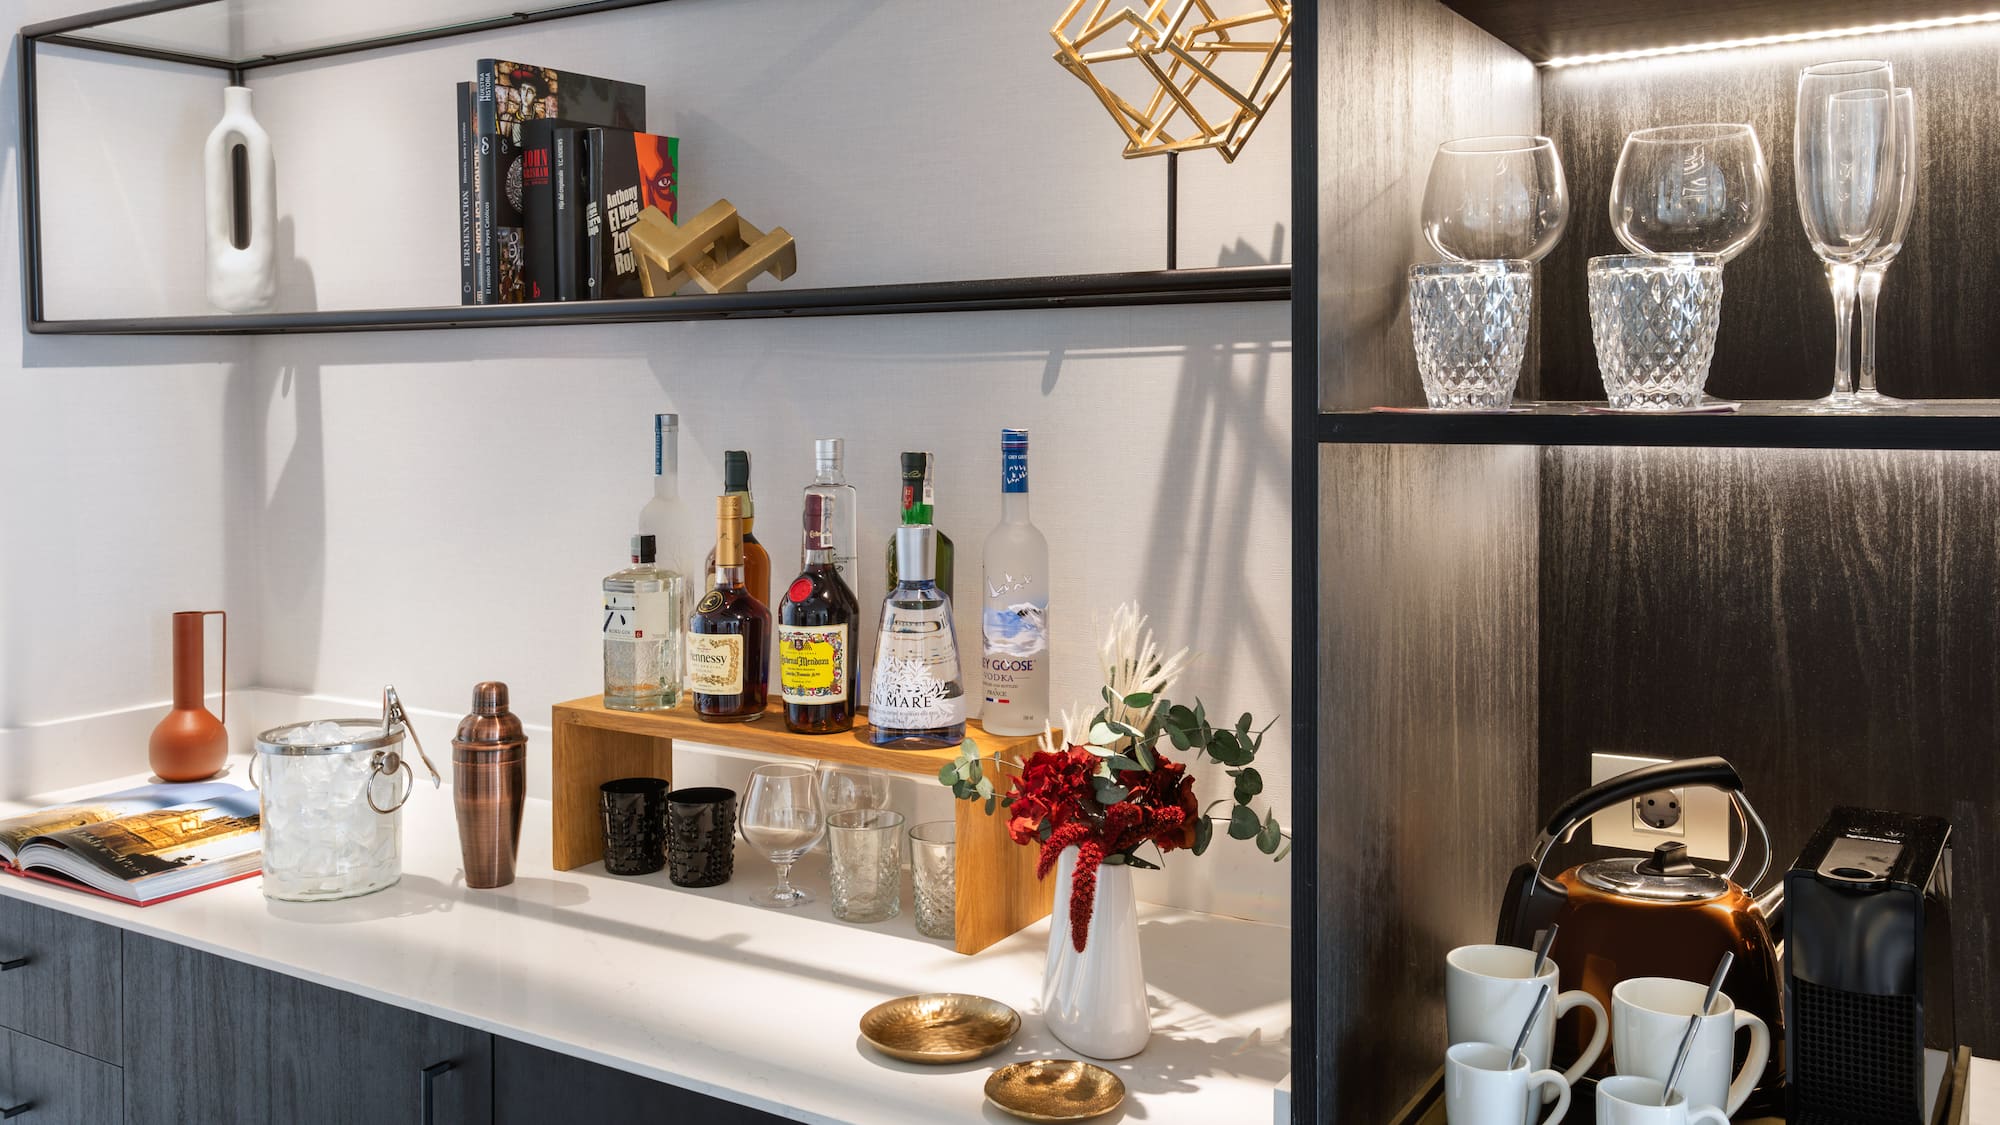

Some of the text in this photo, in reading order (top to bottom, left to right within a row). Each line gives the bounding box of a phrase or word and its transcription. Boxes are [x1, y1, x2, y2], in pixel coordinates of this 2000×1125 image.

[523, 148, 547, 168] JOHN
[606, 185, 638, 209] Anthony
[608, 207, 620, 232] El
[619, 201, 639, 220] Hyde
[614, 248, 637, 276] Roj
[692, 654, 727, 666] ennessy
[992, 659, 1033, 671] GOOSE
[984, 672, 1014, 682] VODKA
[886, 696, 932, 708] MARE
